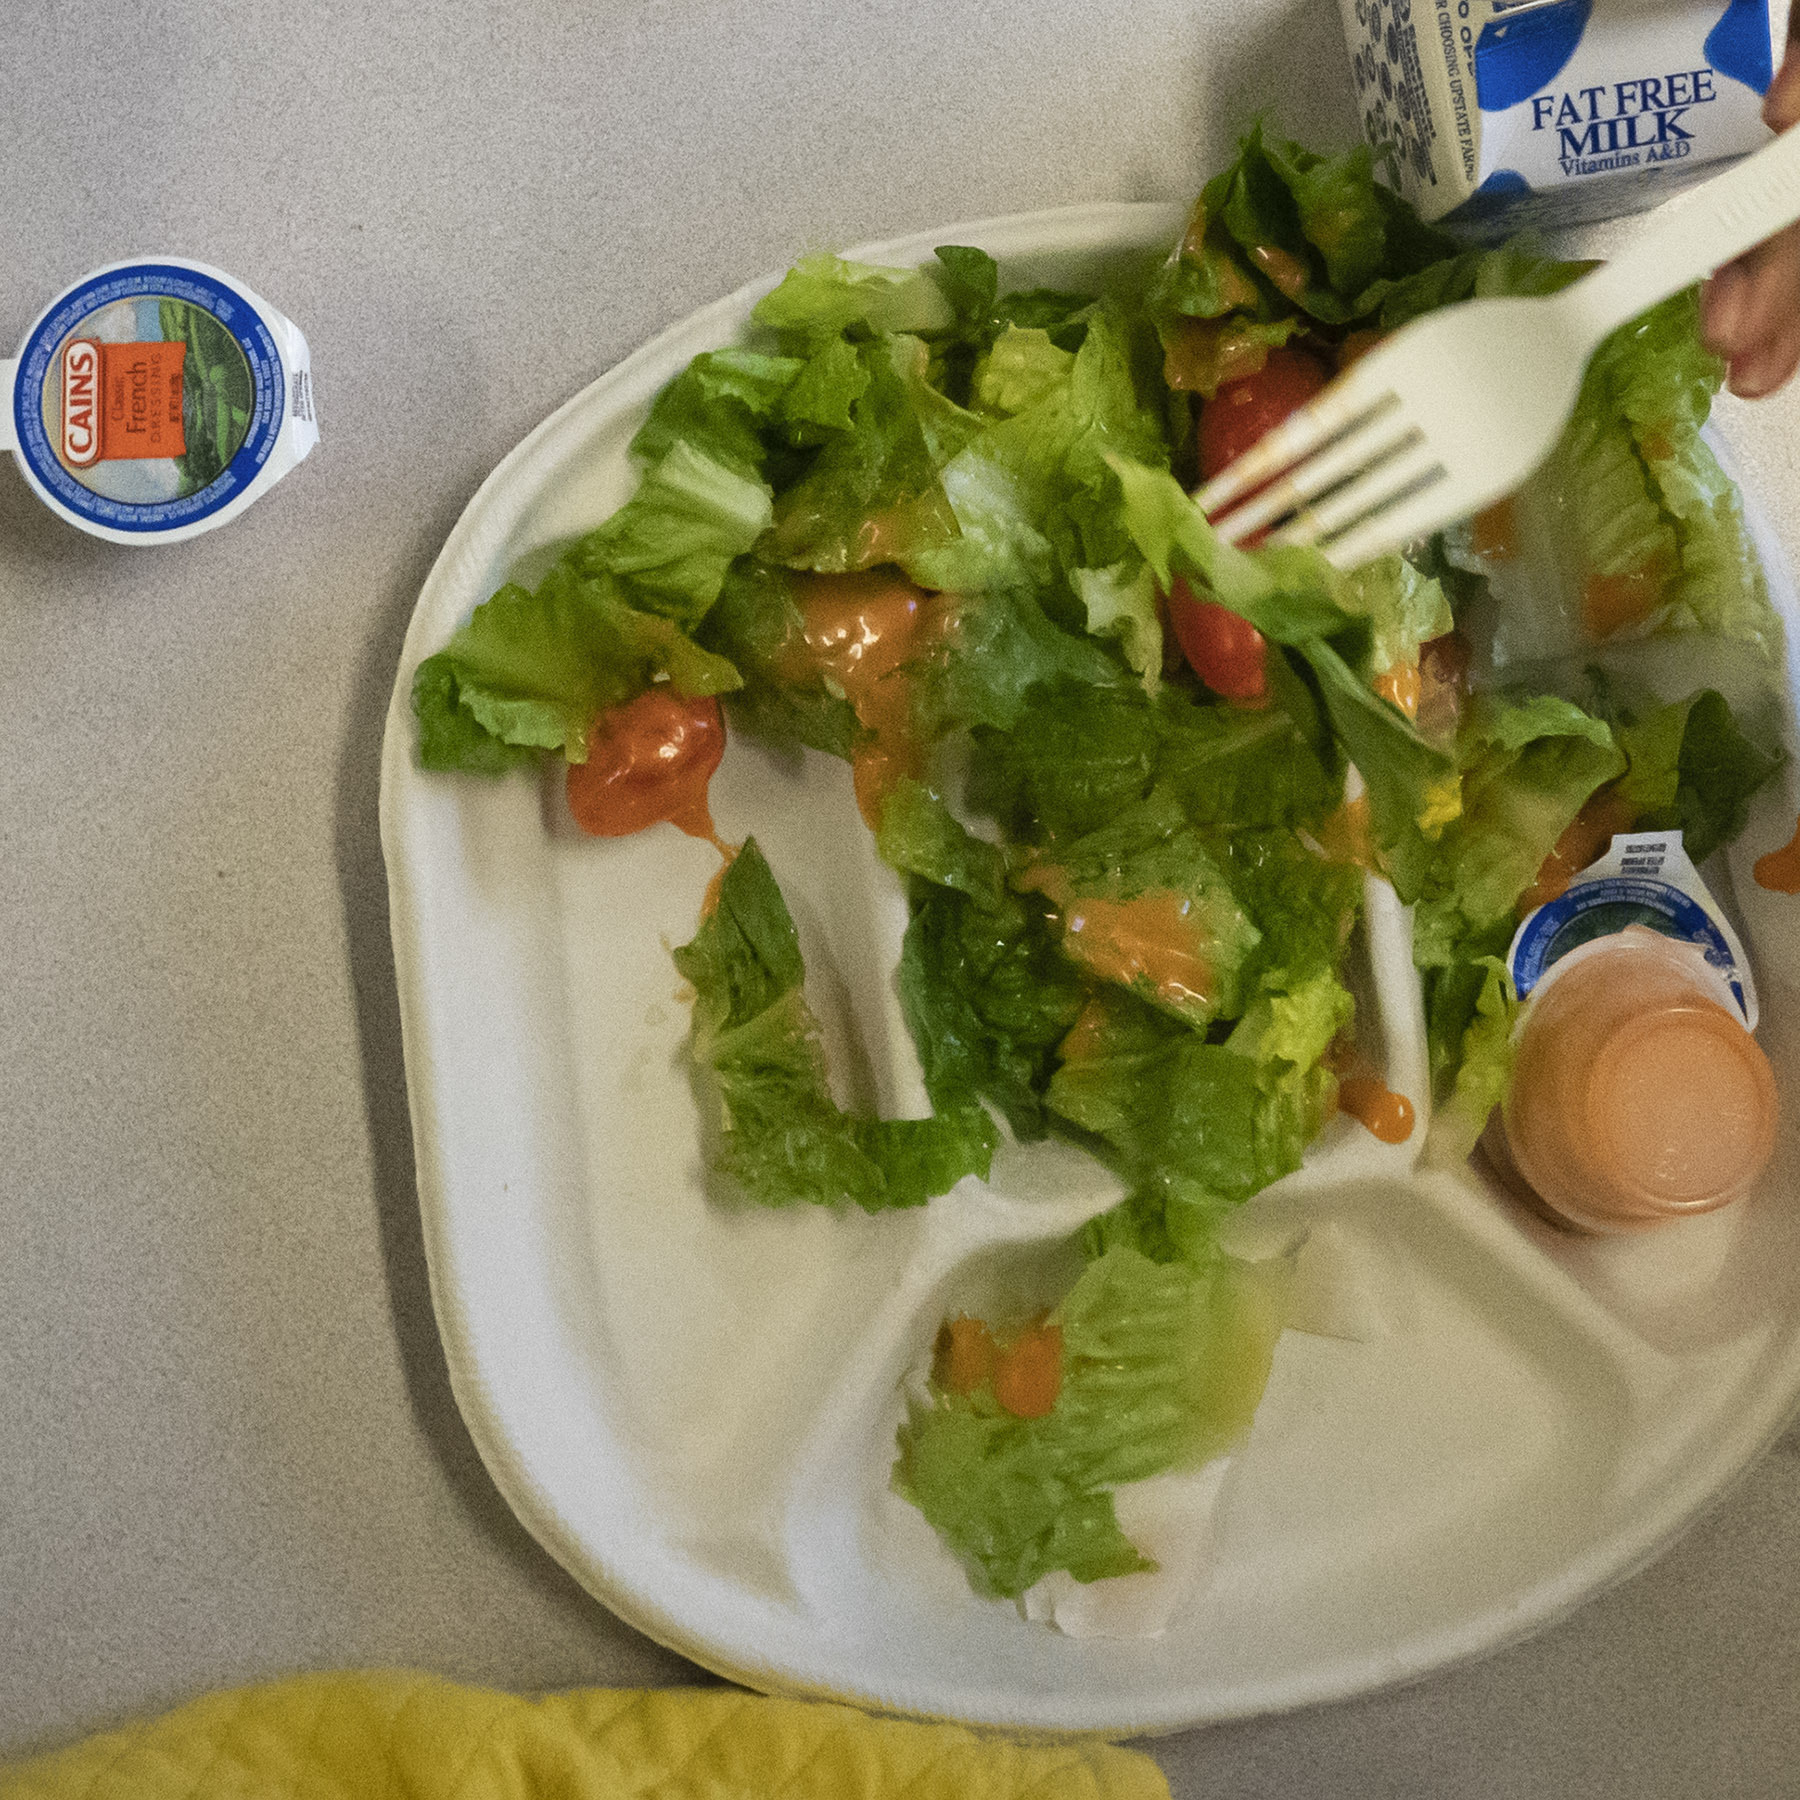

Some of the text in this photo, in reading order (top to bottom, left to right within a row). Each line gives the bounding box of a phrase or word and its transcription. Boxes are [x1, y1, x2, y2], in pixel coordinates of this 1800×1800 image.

[1438, 11, 1460, 78] CHOOSING
[1449, 78, 1471, 137] UPSTATE
[1531, 68, 1718, 132] FAT FREE
[1557, 106, 1695, 162] MILK
[1559, 139, 1692, 178] Vitamins A&D
[69, 351, 94, 454] CAINS
[126, 360, 147, 437] French
[151, 352, 162, 444] DRESSING
